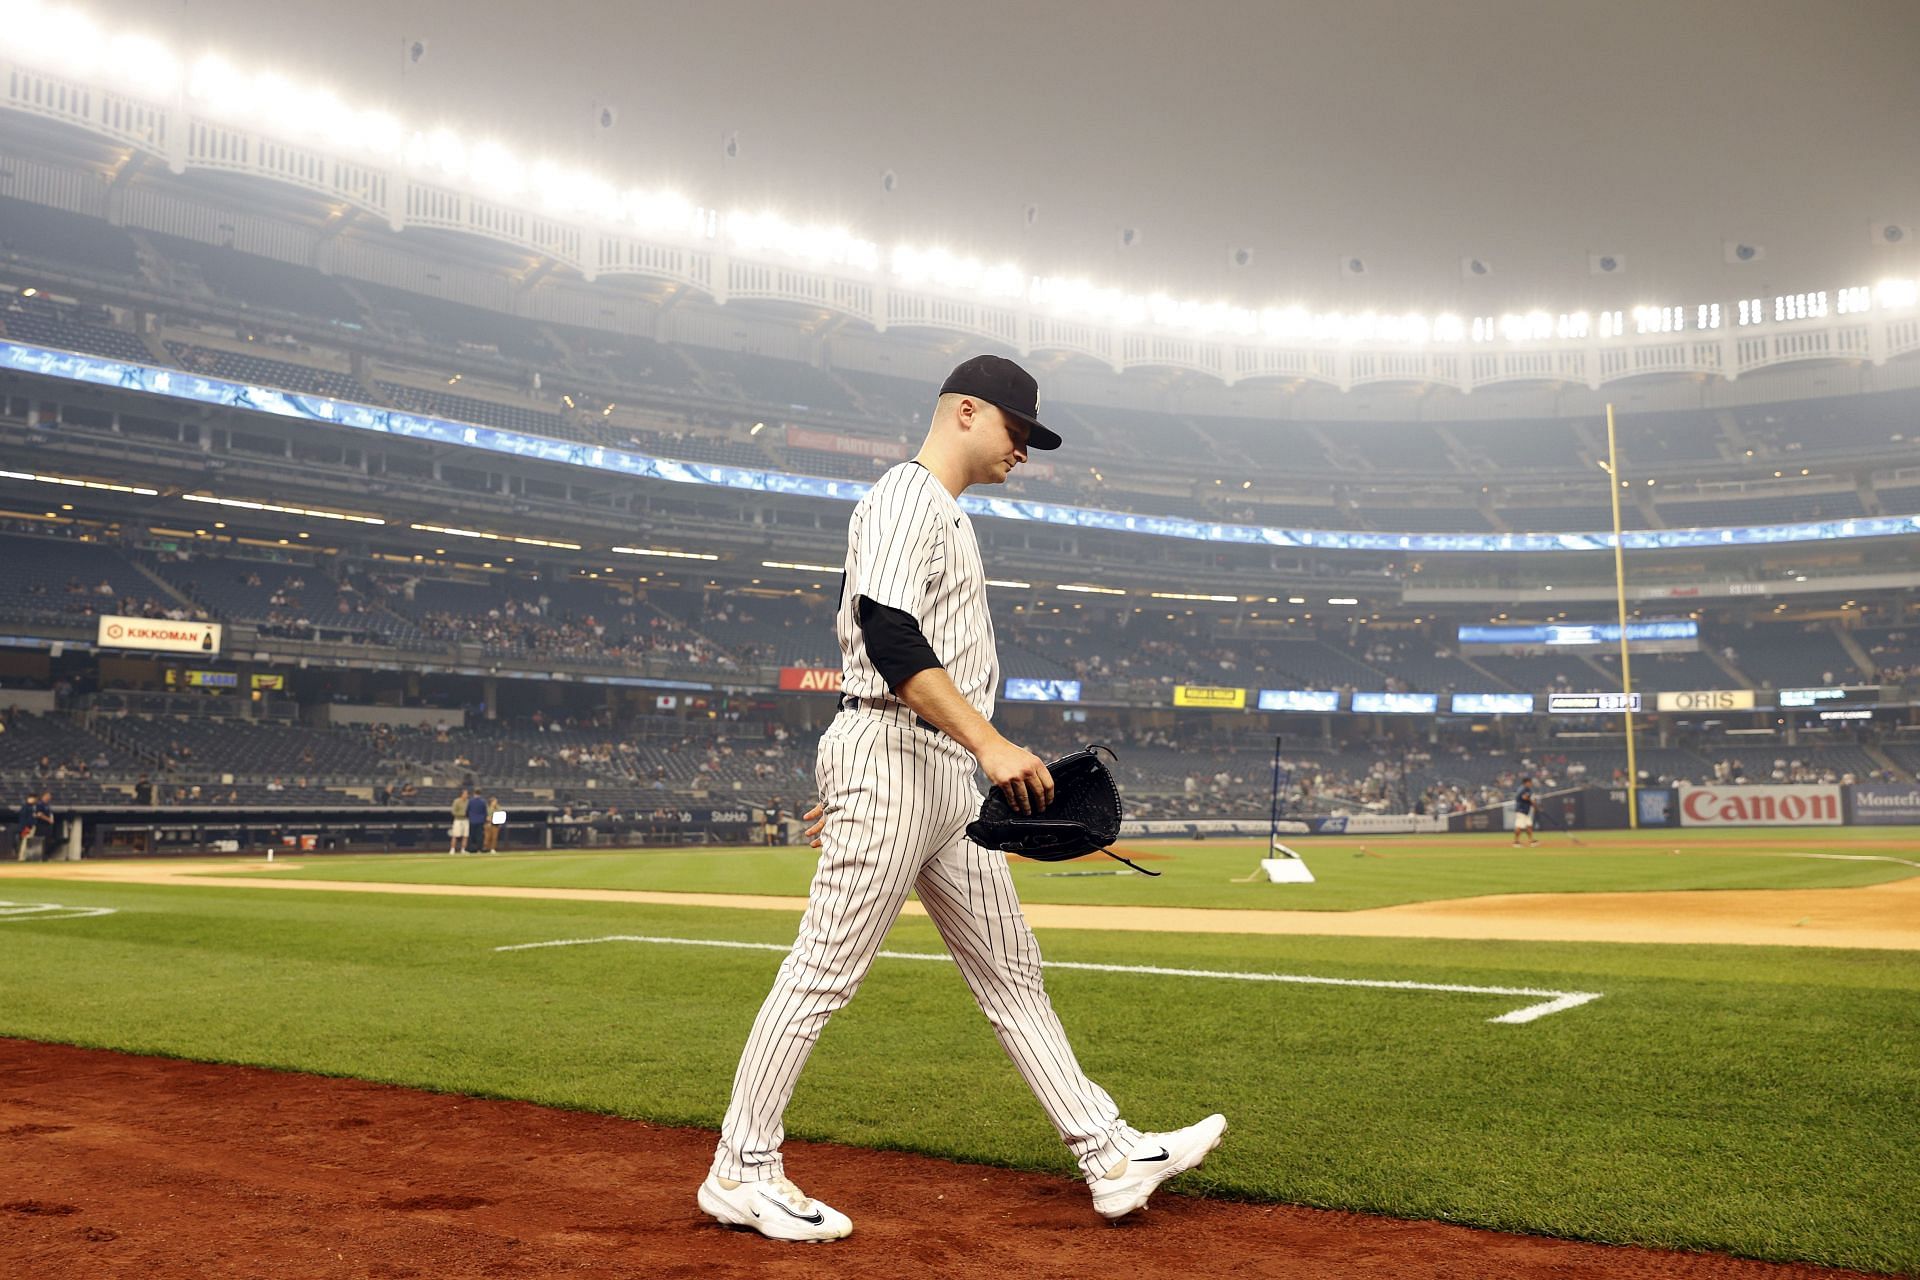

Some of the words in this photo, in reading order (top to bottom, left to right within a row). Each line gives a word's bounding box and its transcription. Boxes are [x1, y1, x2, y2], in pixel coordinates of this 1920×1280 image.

[836, 437, 870, 455] PARTY
[128, 628, 198, 641] KIKKOMAN
[800, 669, 842, 690] AVIS
[1676, 692, 1734, 709] ORIS
[1683, 790, 1836, 821] Canon
[712, 810, 748, 822] StubHub
